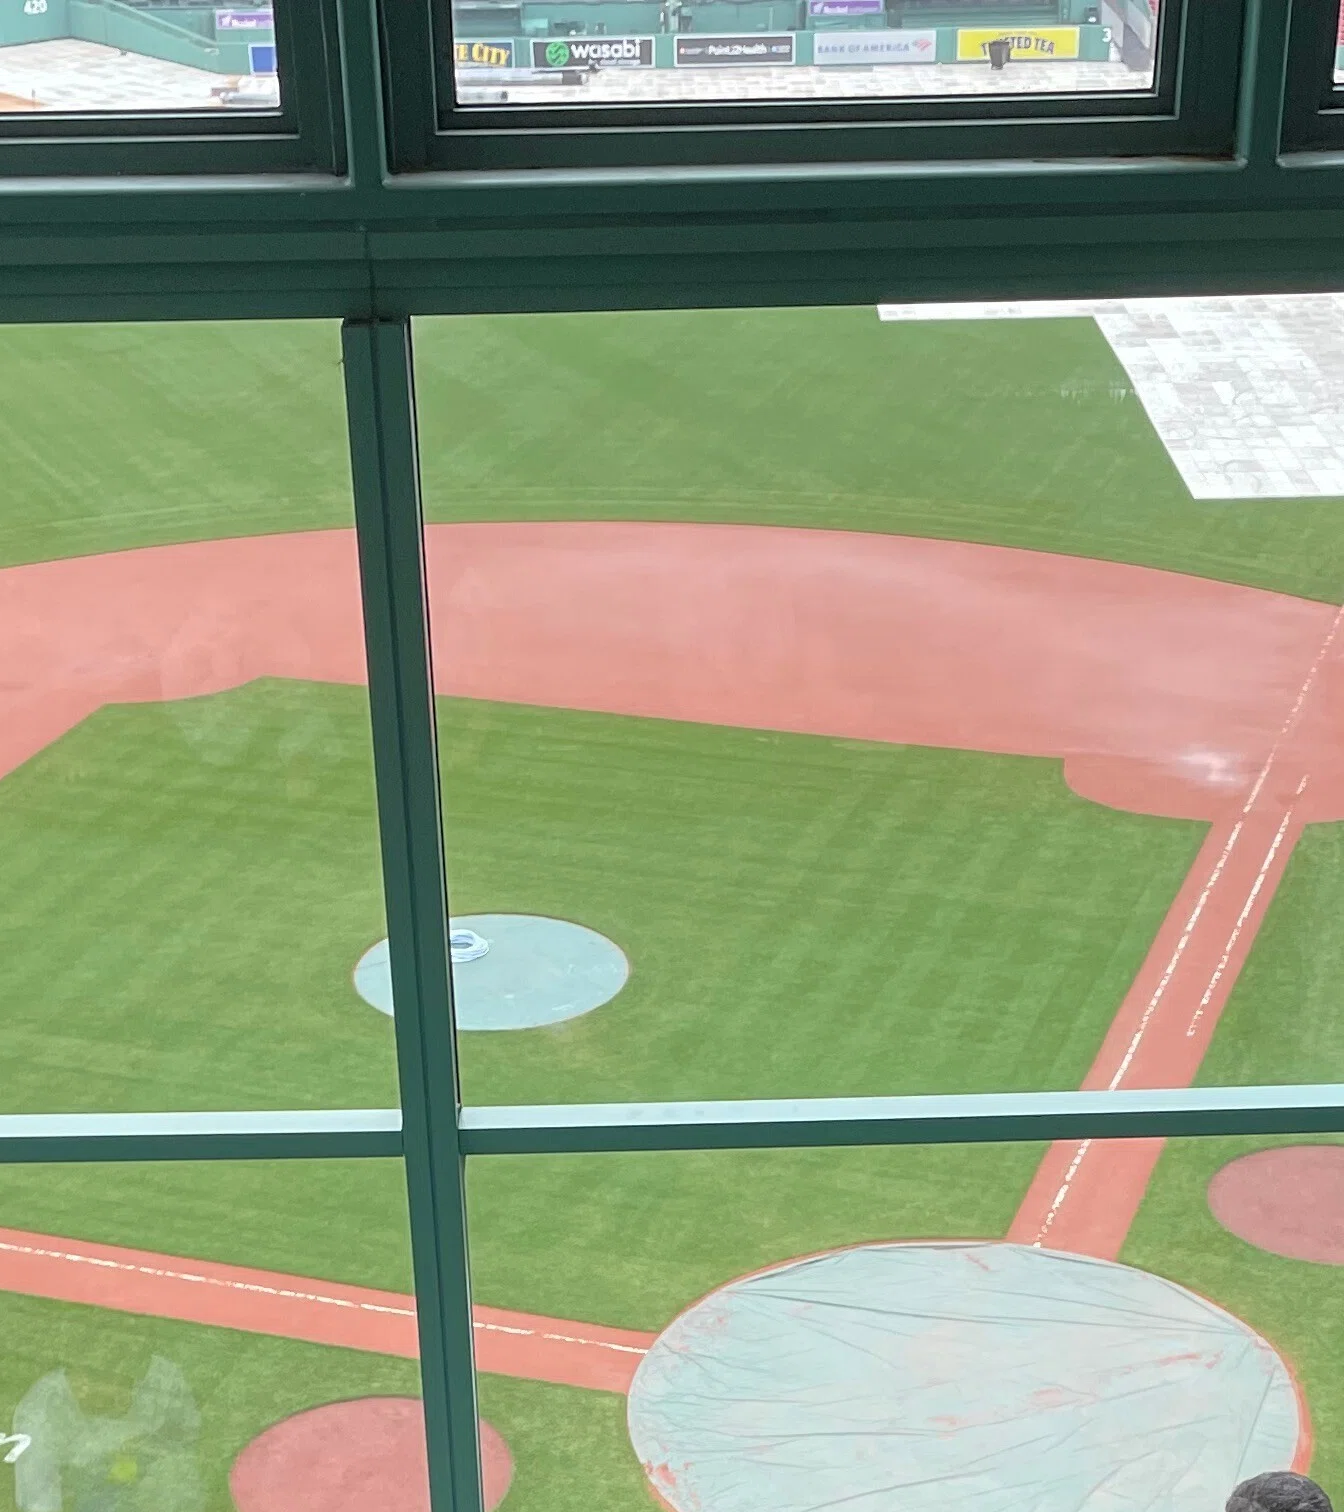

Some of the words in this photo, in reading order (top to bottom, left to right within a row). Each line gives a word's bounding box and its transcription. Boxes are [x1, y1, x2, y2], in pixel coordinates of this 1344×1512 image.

[570, 39, 640, 58] wasabi
[817, 45, 845, 54] BANK
[863, 42, 910, 53] AMERICA
[980, 36, 1032, 56] TTED
[1034, 37, 1056, 55] TEA
